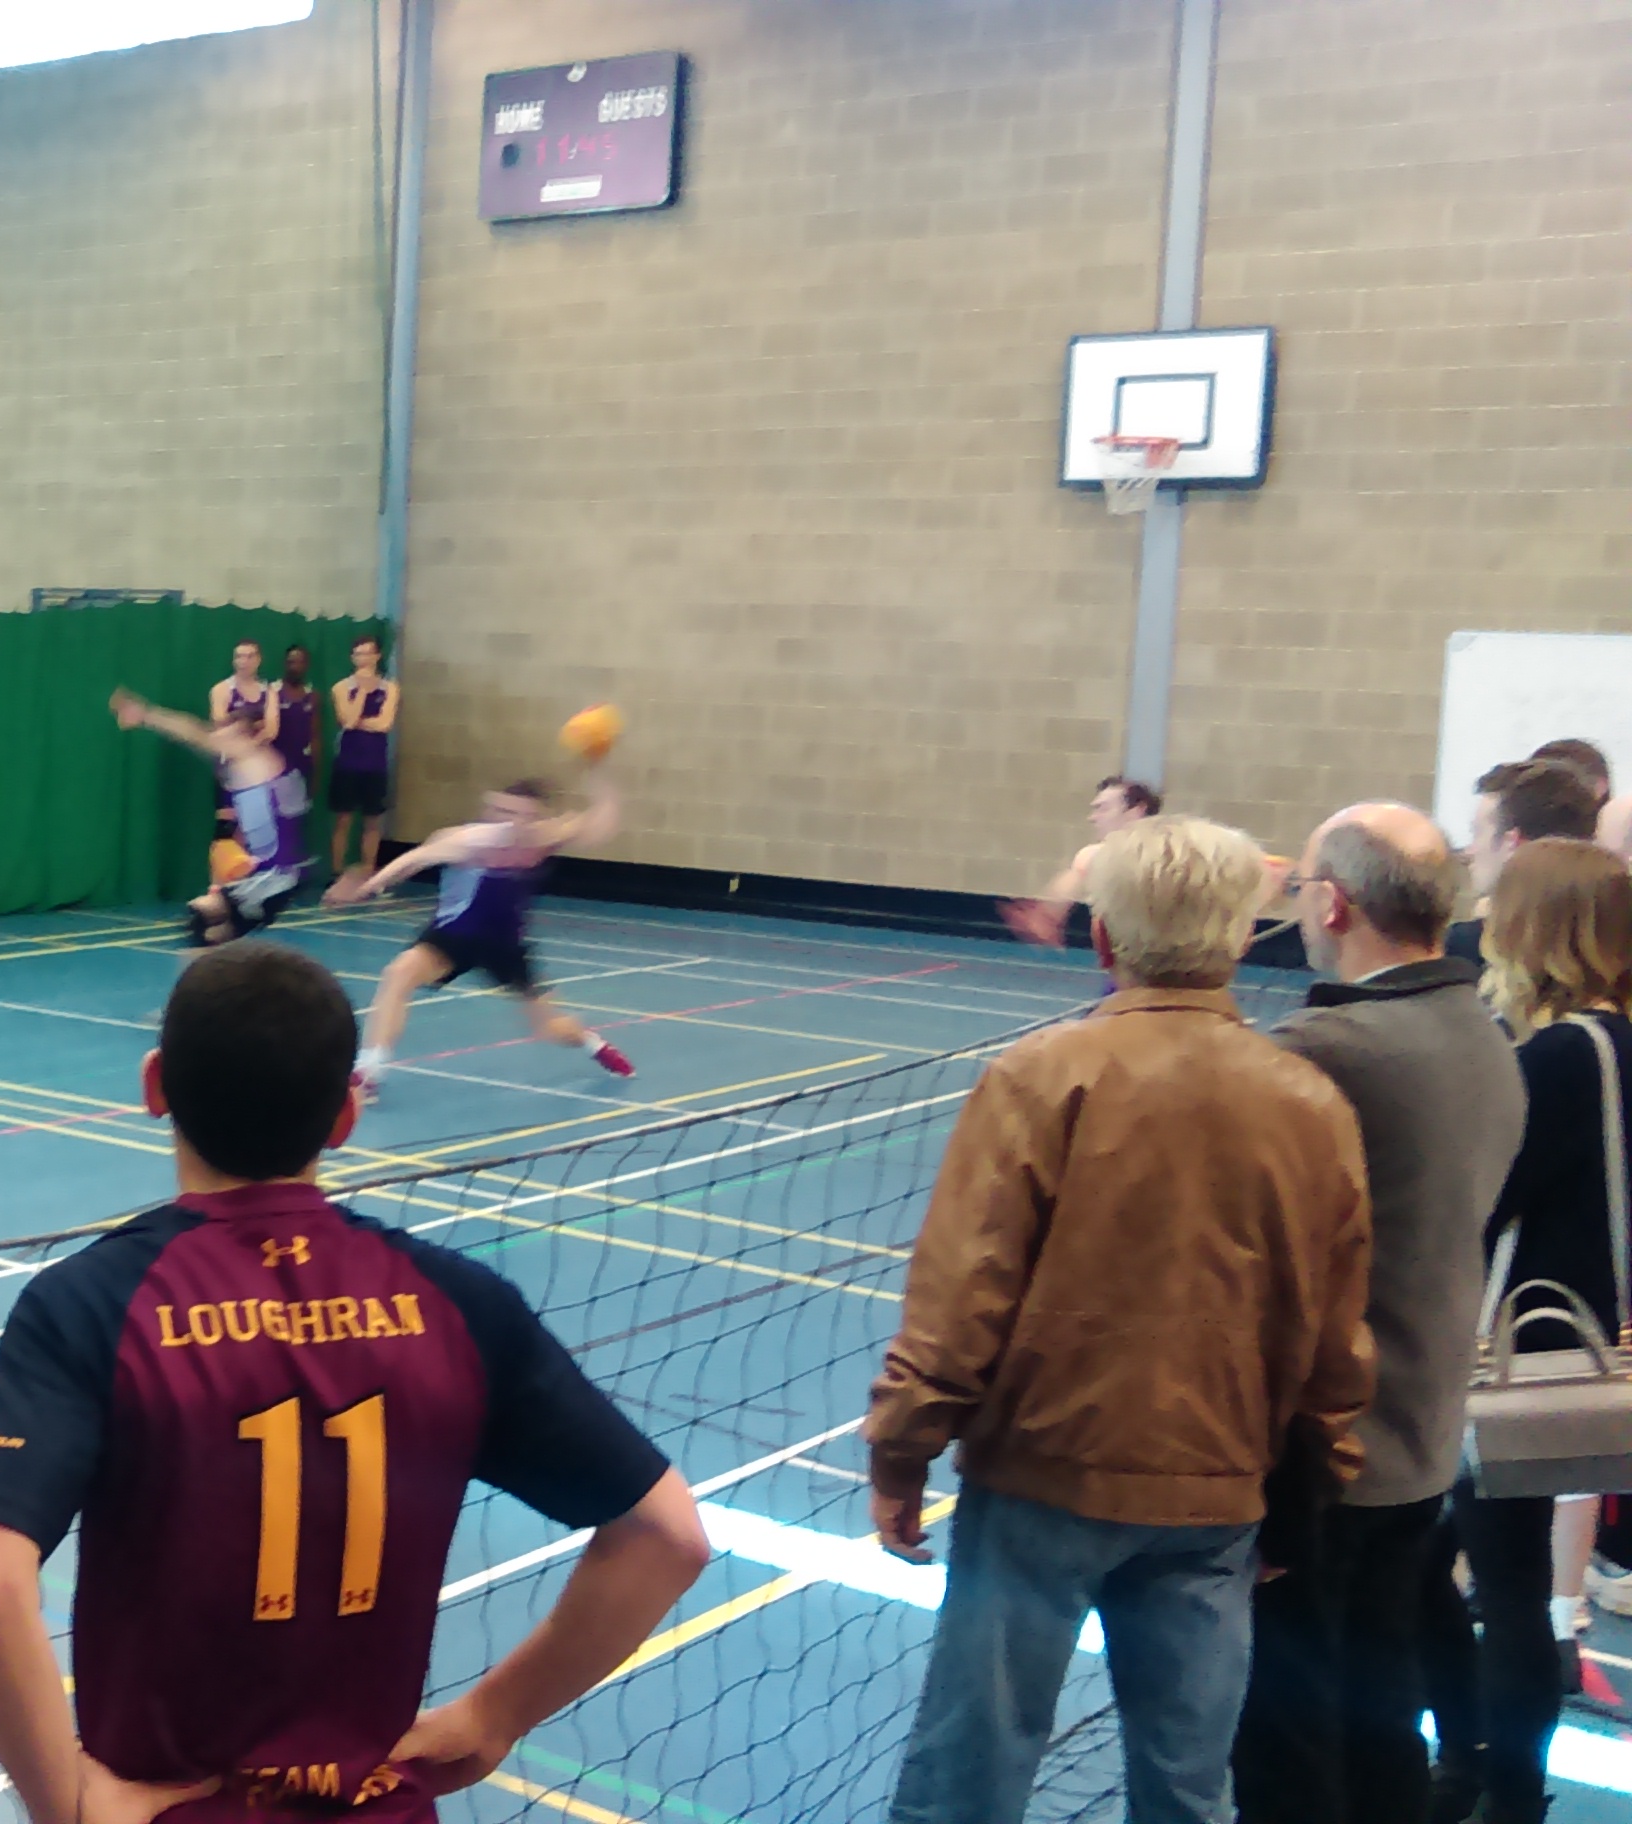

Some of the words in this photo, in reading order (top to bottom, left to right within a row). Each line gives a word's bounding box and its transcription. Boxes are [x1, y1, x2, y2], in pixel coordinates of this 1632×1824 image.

[598, 85, 668, 122] GUESTS
[156, 1294, 425, 1346] LOUGHRAN
[238, 1394, 387, 1622] 11
